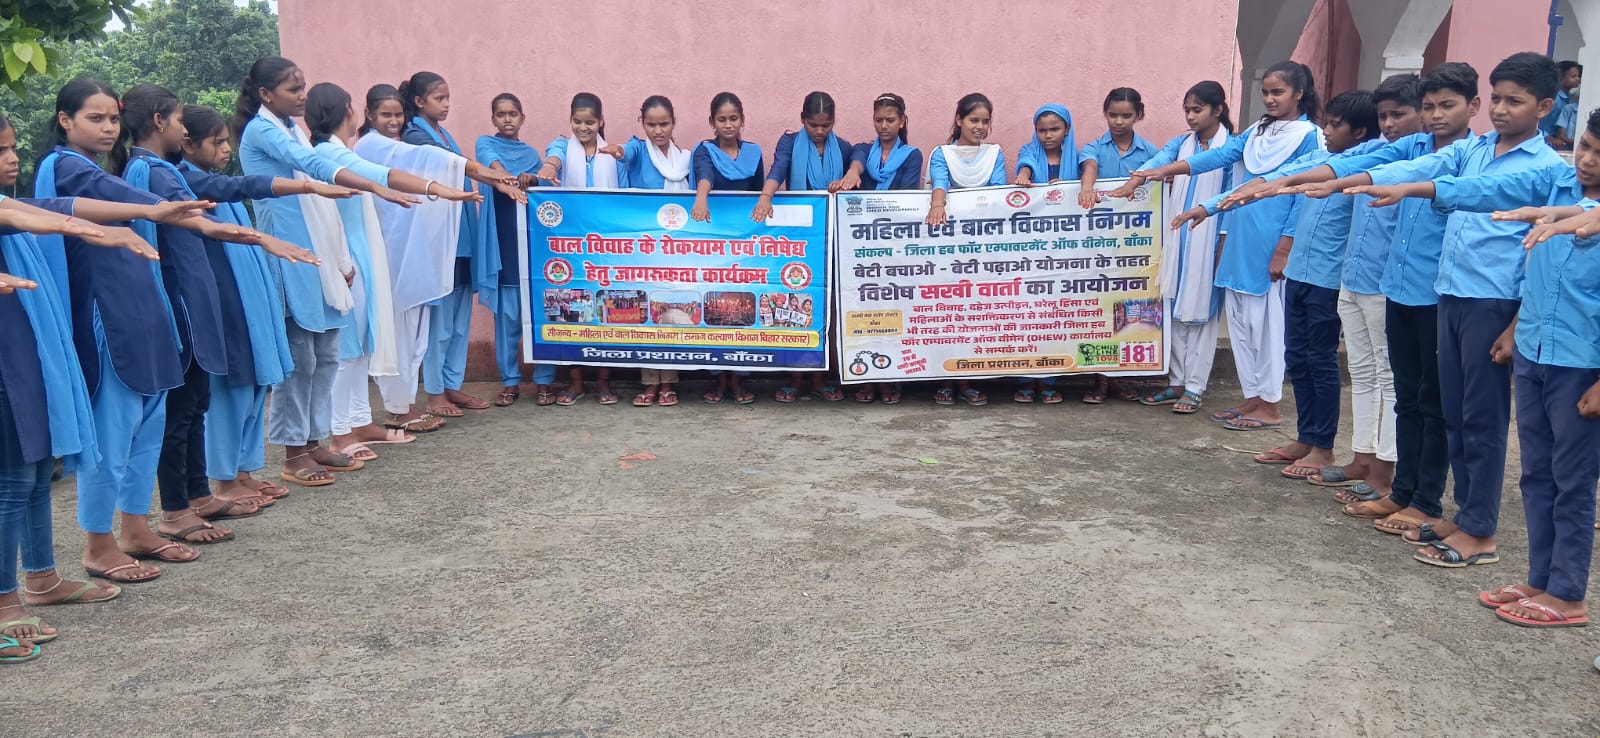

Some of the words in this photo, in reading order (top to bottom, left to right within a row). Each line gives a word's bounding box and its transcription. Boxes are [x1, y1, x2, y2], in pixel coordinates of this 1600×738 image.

[850, 217, 922, 240] महिला
[927, 215, 956, 237] एवं
[960, 217, 1005, 236] बाल
[1009, 211, 1082, 234] विकास
[1086, 208, 1152, 231] निगम
[548, 237, 583, 253] बाल
[586, 234, 635, 254] विवाह
[638, 234, 656, 254] के
[729, 235, 755, 255] एवं
[853, 246, 893, 258] संकल्प
[904, 244, 936, 256] जिला
[938, 245, 956, 255] हब
[958, 241, 982, 254] फॉर
[984, 238, 1048, 253] एम्पावरमेंट
[1052, 237, 1079, 250] ऑफ
[1124, 232, 1153, 247] बाँका
[584, 261, 610, 287] हेतु
[701, 263, 768, 284] कार्यक्रम
[853, 263, 882, 278] बेटी
[885, 261, 936, 277] बचाओ
[951, 259, 980, 274] बेटी
[982, 256, 1032, 275] पढ़ाओ
[1034, 256, 1091, 272] योजना
[1094, 253, 1112, 269] के
[1114, 254, 1151, 268] तहत
[858, 282, 916, 301] विशेष
[919, 280, 973, 300] सखी
[976, 277, 1022, 298] वार्ता
[1024, 280, 1055, 296] का
[1060, 273, 1150, 294] आयोजन
[969, 301, 992, 311] दहेज
[1034, 299, 1058, 312] घरेलू
[1060, 298, 1082, 307] हिंसा
[1084, 297, 1099, 306] एवं
[909, 313, 953, 325] महिलाओं
[954, 313, 965, 322] के
[1027, 310, 1036, 319] से
[1077, 308, 1103, 318] किसी
[907, 326, 918, 335] भी
[920, 327, 940, 335] तरह
[942, 324, 955, 334] की
[958, 322, 1001, 333] योजनाओं
[1003, 322, 1017, 332] की
[1019, 320, 1061, 331] जानकारी
[1063, 320, 1089, 330] जिला
[901, 336, 920, 346] फॉर
[973, 335, 997, 344] ऑफ
[1027, 333, 1067, 342] (DHEW)
[1070, 330, 1112, 341] कार्यालय
[582, 347, 631, 359] जिला
[636, 350, 718, 362] प्रशासन,
[723, 350, 774, 362] बाँका
[974, 346, 983, 354] से
[1122, 344, 1154, 362] 181
[956, 359, 985, 369] जिला
[987, 358, 1032, 369] प्रशासन,
[1035, 356, 1065, 367] बाँका
